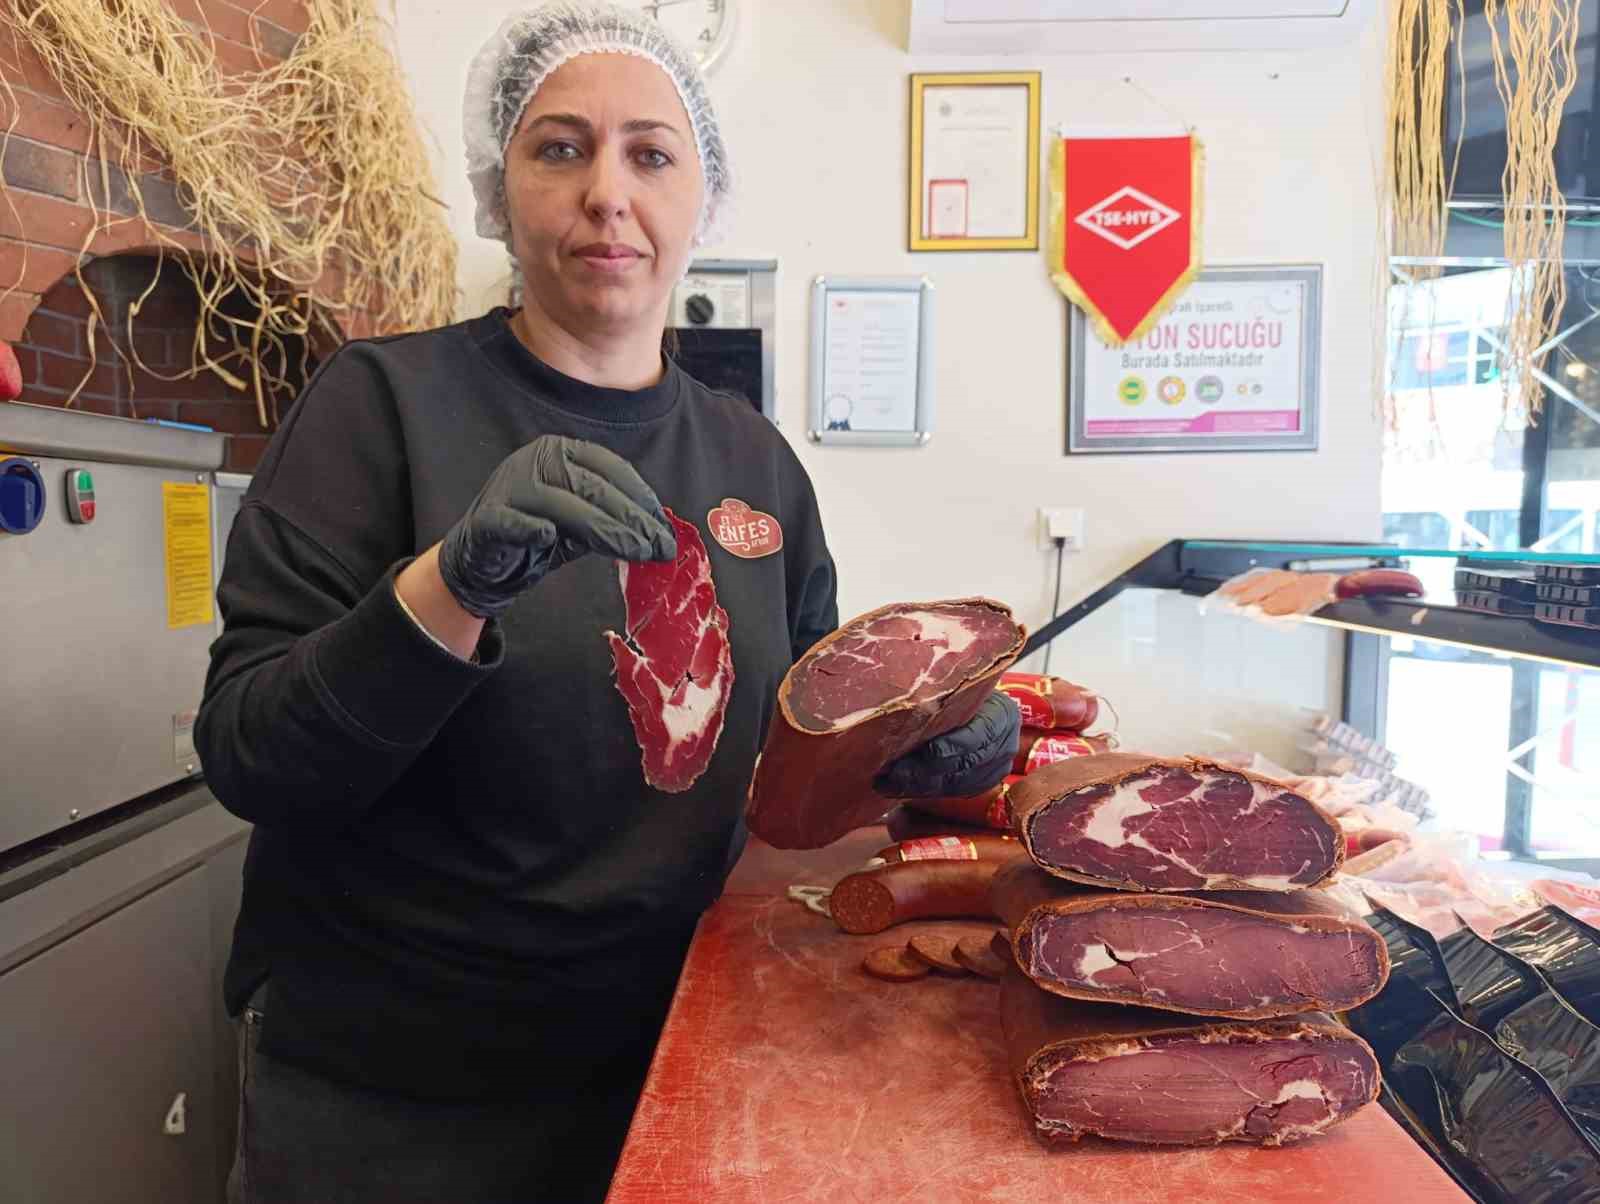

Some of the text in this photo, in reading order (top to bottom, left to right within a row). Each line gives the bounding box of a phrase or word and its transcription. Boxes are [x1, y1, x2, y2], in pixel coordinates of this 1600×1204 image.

[1187, 315, 1282, 349] SUCUĞU
[1121, 353, 1168, 368] Burada
[719, 519, 770, 543] ENFES
